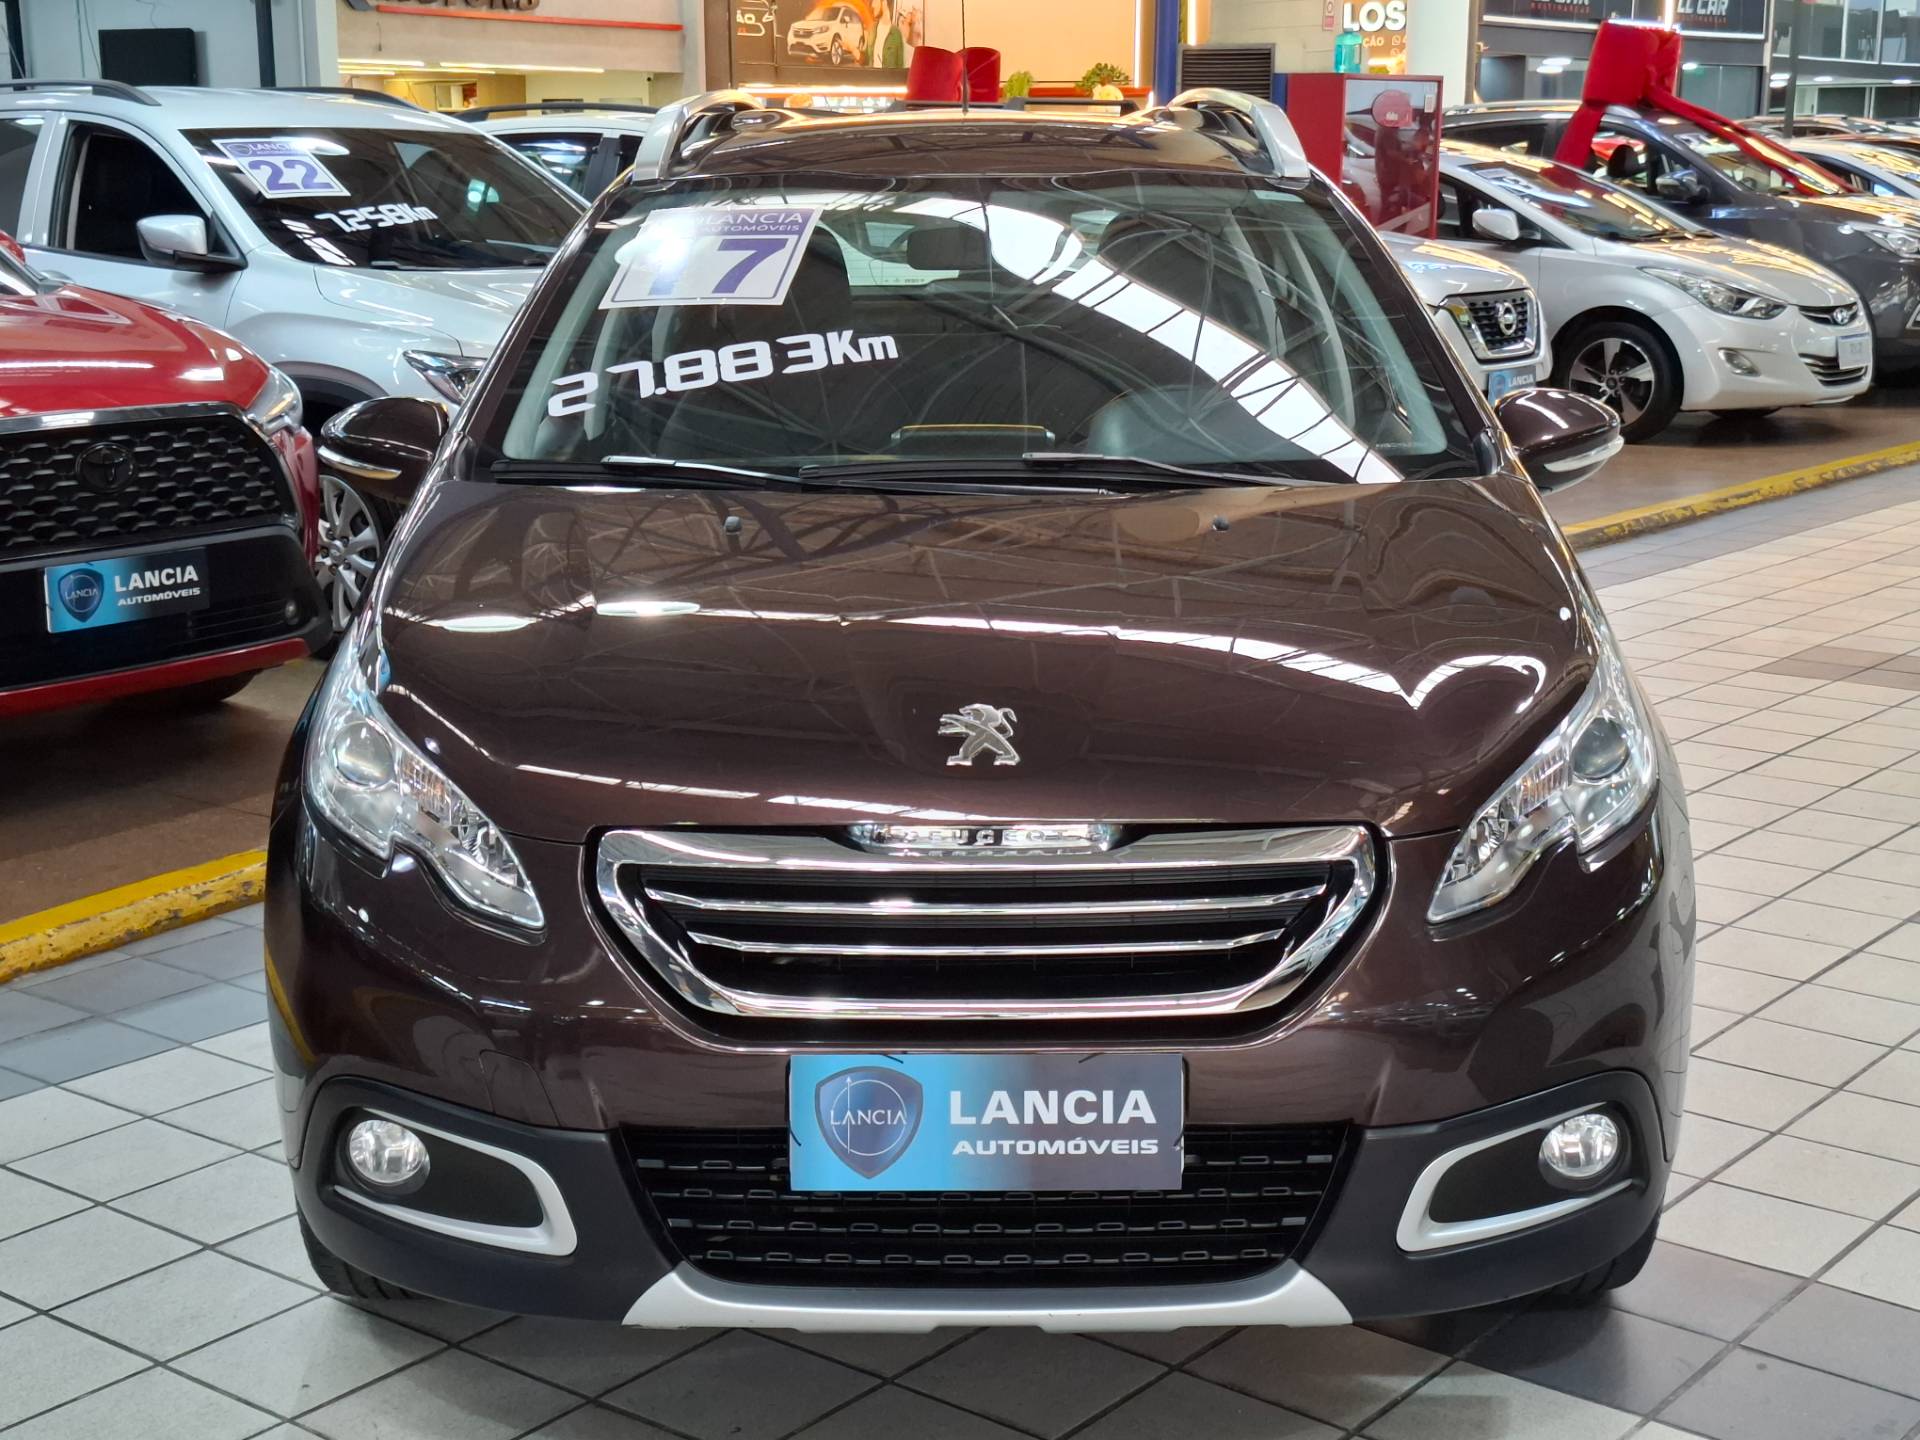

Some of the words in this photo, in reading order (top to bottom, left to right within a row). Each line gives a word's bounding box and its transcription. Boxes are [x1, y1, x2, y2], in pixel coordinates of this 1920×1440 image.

[248, 160, 334, 191] 22
[707, 212, 802, 225] LANCIA
[547, 329, 899, 417] 27.883Km
[114, 565, 199, 592] LANCIA
[64, 587, 98, 600] LANCIA
[117, 587, 201, 607] AUTOMÓVEIS
[830, 1108, 907, 1127] LANCIA
[950, 1090, 1157, 1125] LANCIA
[952, 1136, 1159, 1155] AUTOMÓVEIS
